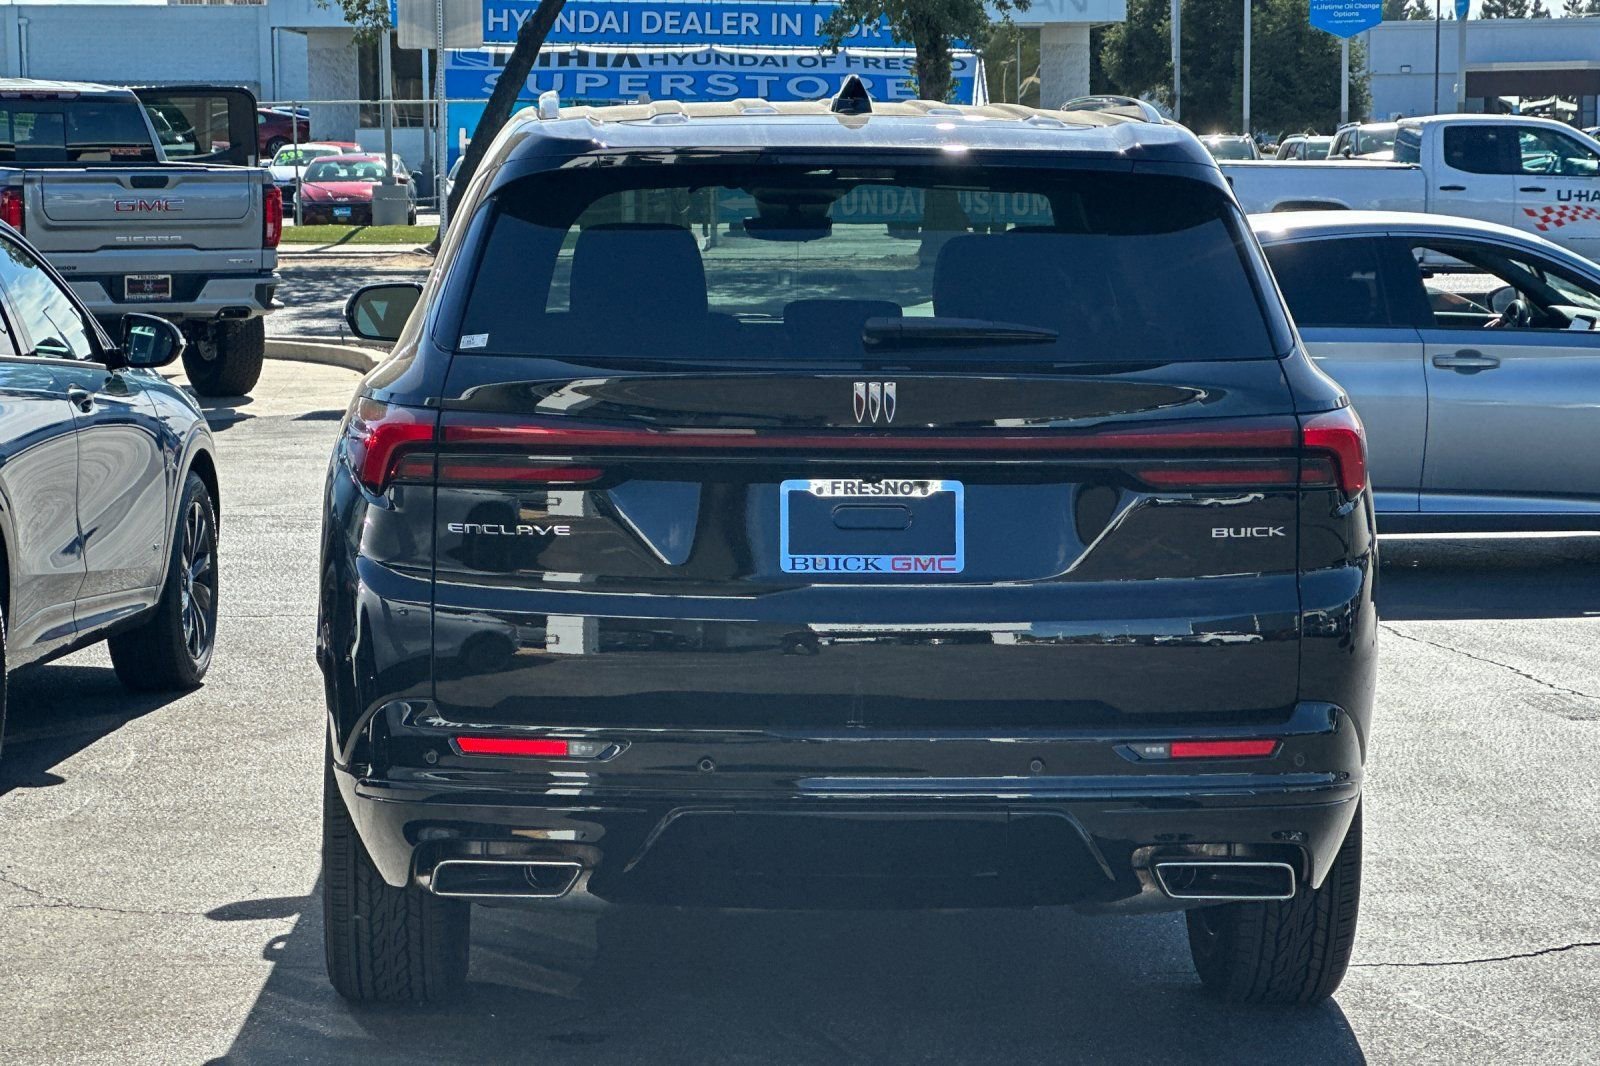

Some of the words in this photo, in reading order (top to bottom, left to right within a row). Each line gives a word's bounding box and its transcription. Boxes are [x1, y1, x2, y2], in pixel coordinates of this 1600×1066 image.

[487, 8, 629, 34] HYNDAI
[641, 11, 759, 37] DEALER
[771, 13, 802, 36] IN
[648, 53, 787, 69] HYUNDAI
[797, 55, 835, 69] OF
[845, 56, 967, 72] FRESO
[114, 199, 185, 212] GMC
[830, 480, 915, 496] FRESNO
[447, 522, 571, 536] ENCLAVE
[1211, 526, 1287, 538] BUICK
[788, 556, 883, 571] BUICK
[891, 556, 957, 571] GMC
